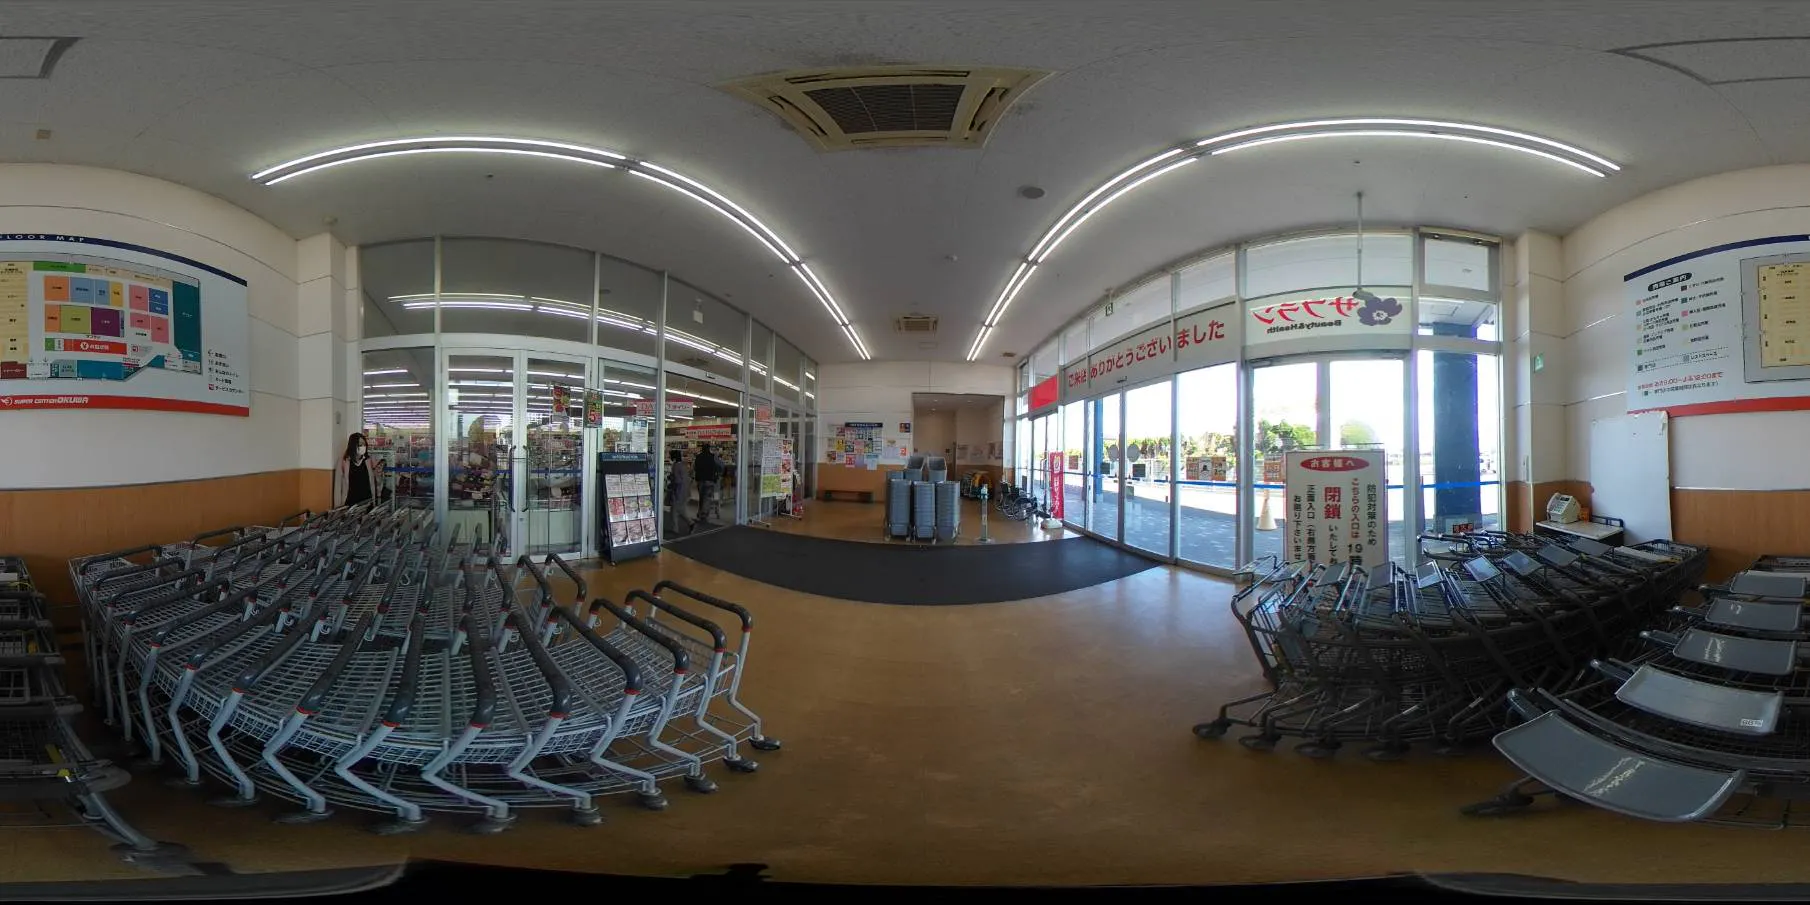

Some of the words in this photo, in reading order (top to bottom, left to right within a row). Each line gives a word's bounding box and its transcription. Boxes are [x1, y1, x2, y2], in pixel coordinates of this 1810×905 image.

[56, 235, 85, 243] MAP
[57, 395, 89, 404] OKUWA
[1310, 458, 1356, 468] お客様へ
[1324, 486, 1342, 520] 閉鎖
[1350, 477, 1361, 539] こちらの入口は
[1366, 484, 1378, 547] 防犯対策のため
